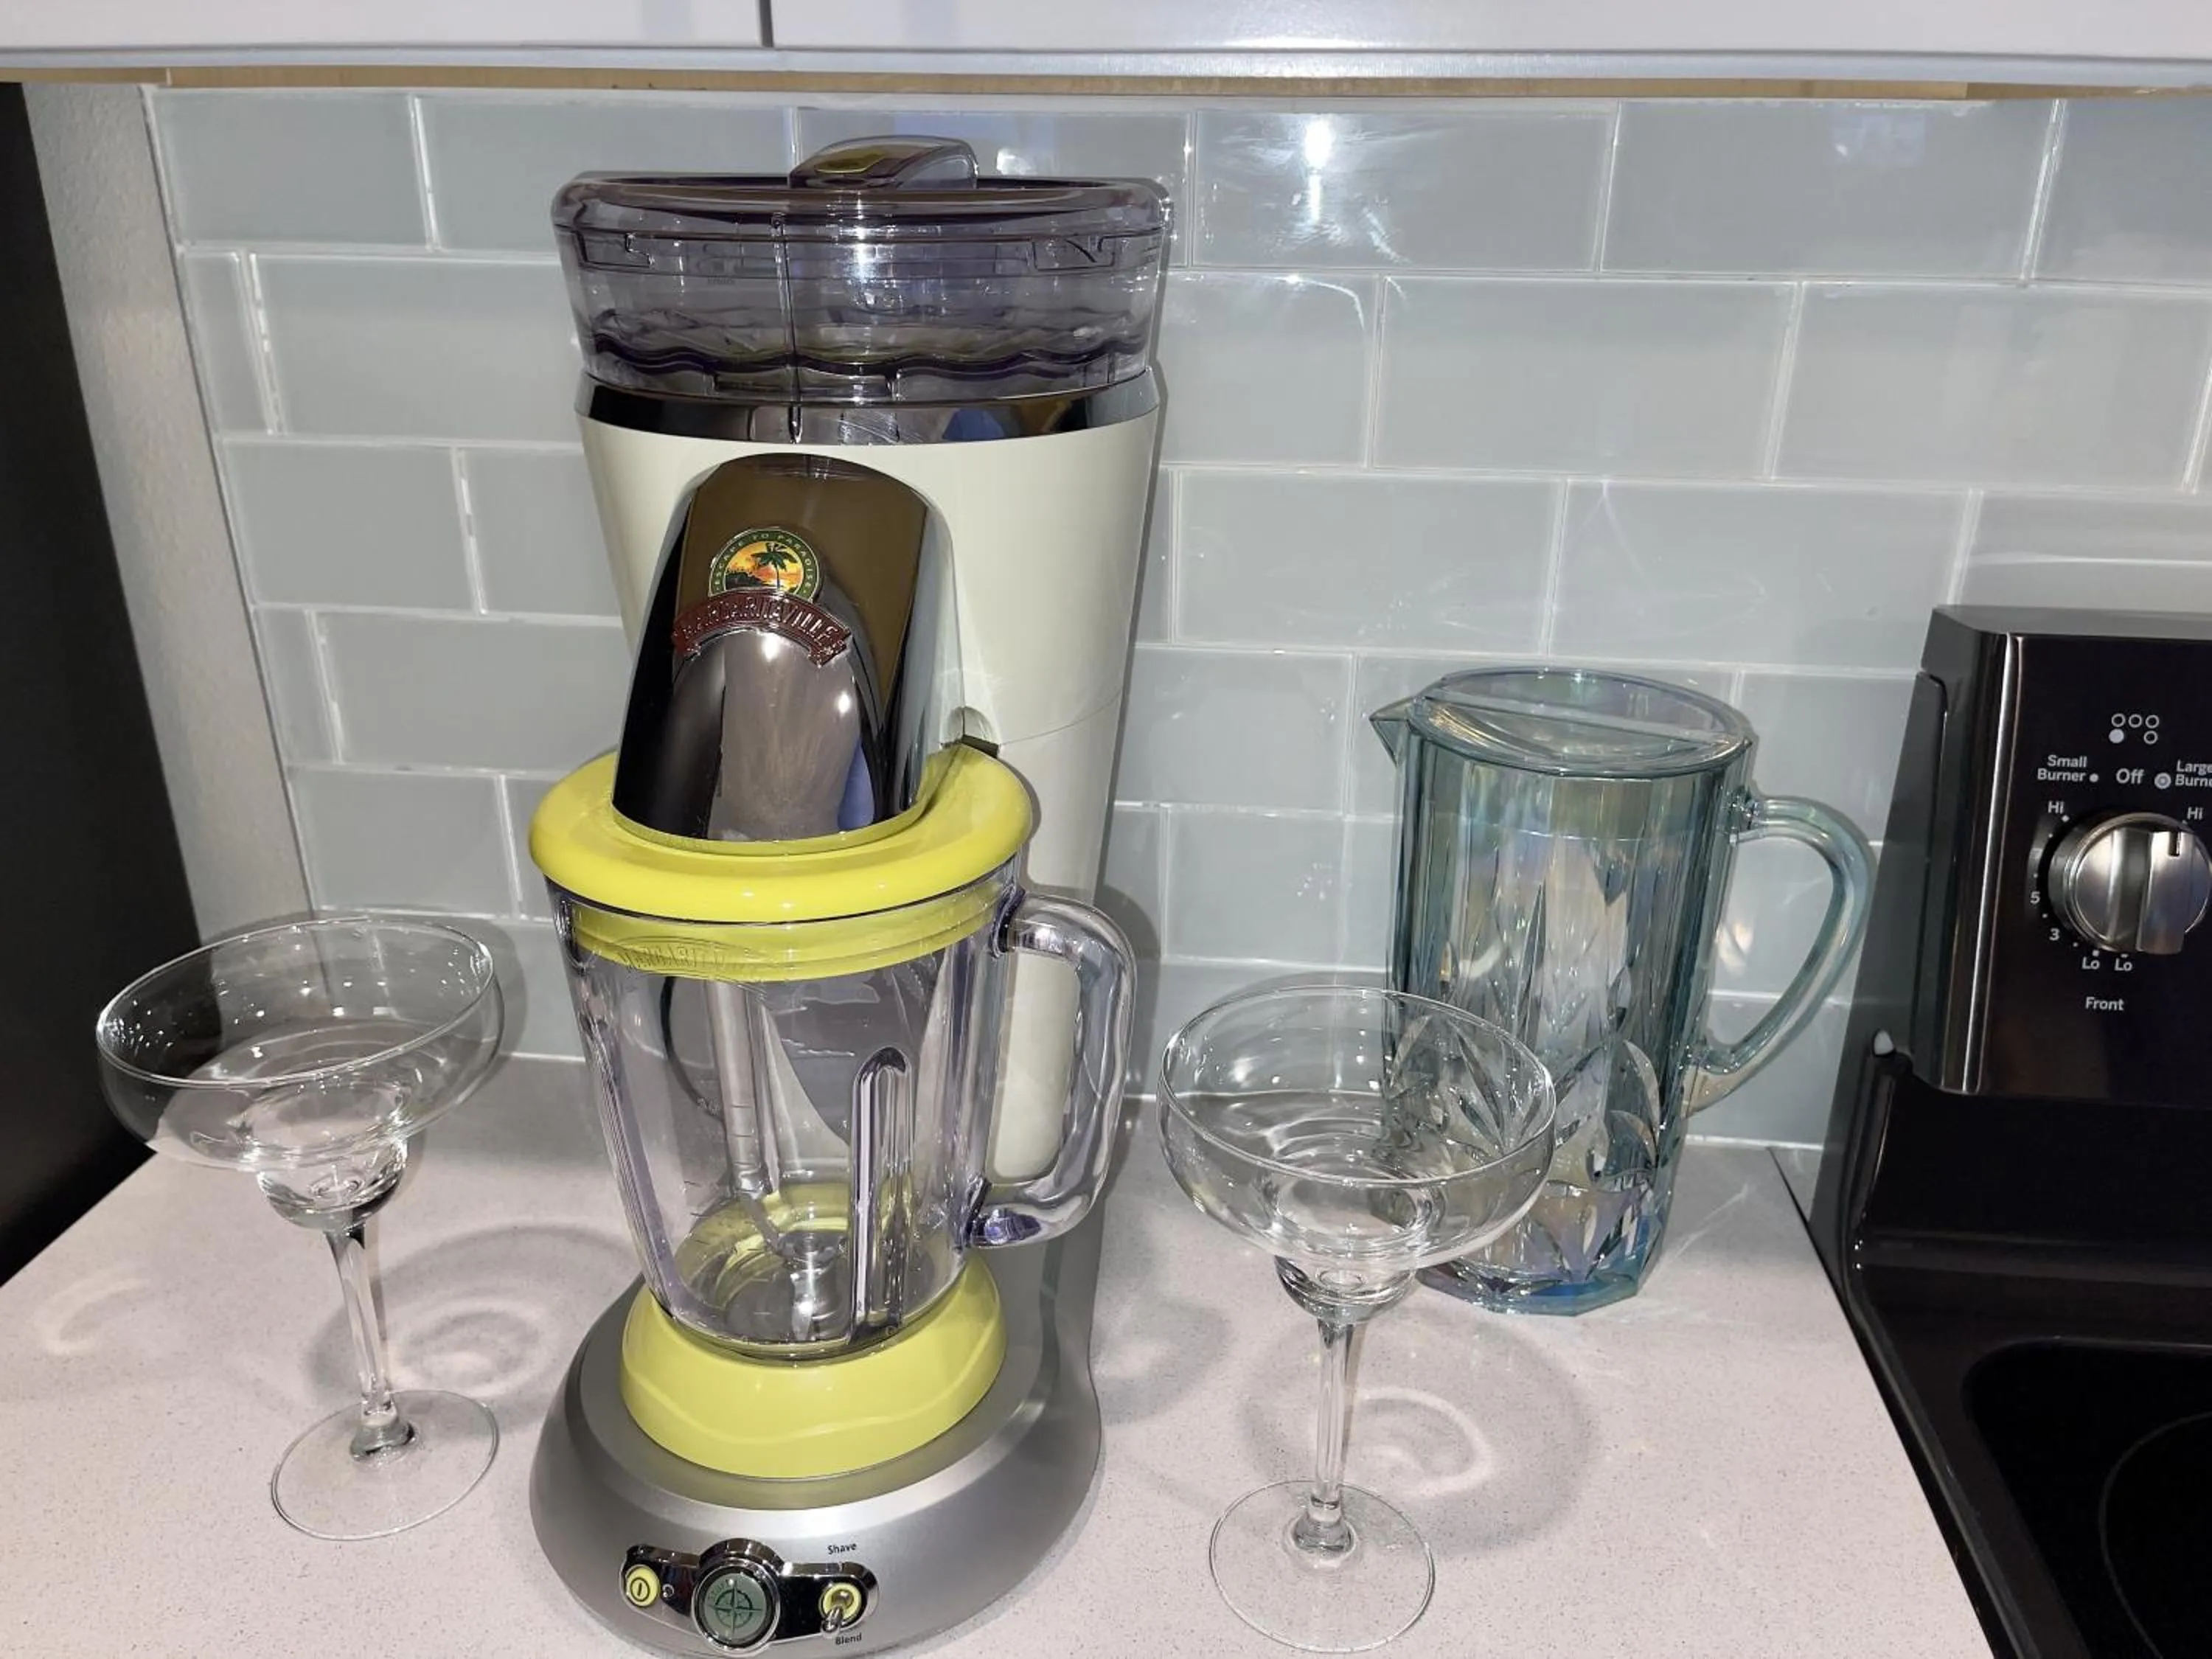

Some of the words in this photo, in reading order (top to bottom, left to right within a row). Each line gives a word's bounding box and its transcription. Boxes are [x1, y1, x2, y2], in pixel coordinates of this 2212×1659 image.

[2047, 754, 2087, 768] Small
[2037, 768, 2085, 782] Burner
[2115, 768, 2144, 784] Off
[2048, 801, 2065, 814] Hi
[2187, 807, 2204, 820] Hi
[2030, 891, 2040, 904] 5
[2049, 928, 2060, 941] 3
[2082, 957, 2100, 970] Lo
[2115, 959, 2132, 971] Lo
[2085, 996, 2124, 1011] Front
[827, 1543, 857, 1554] Shave
[835, 1632, 862, 1645] Blend
